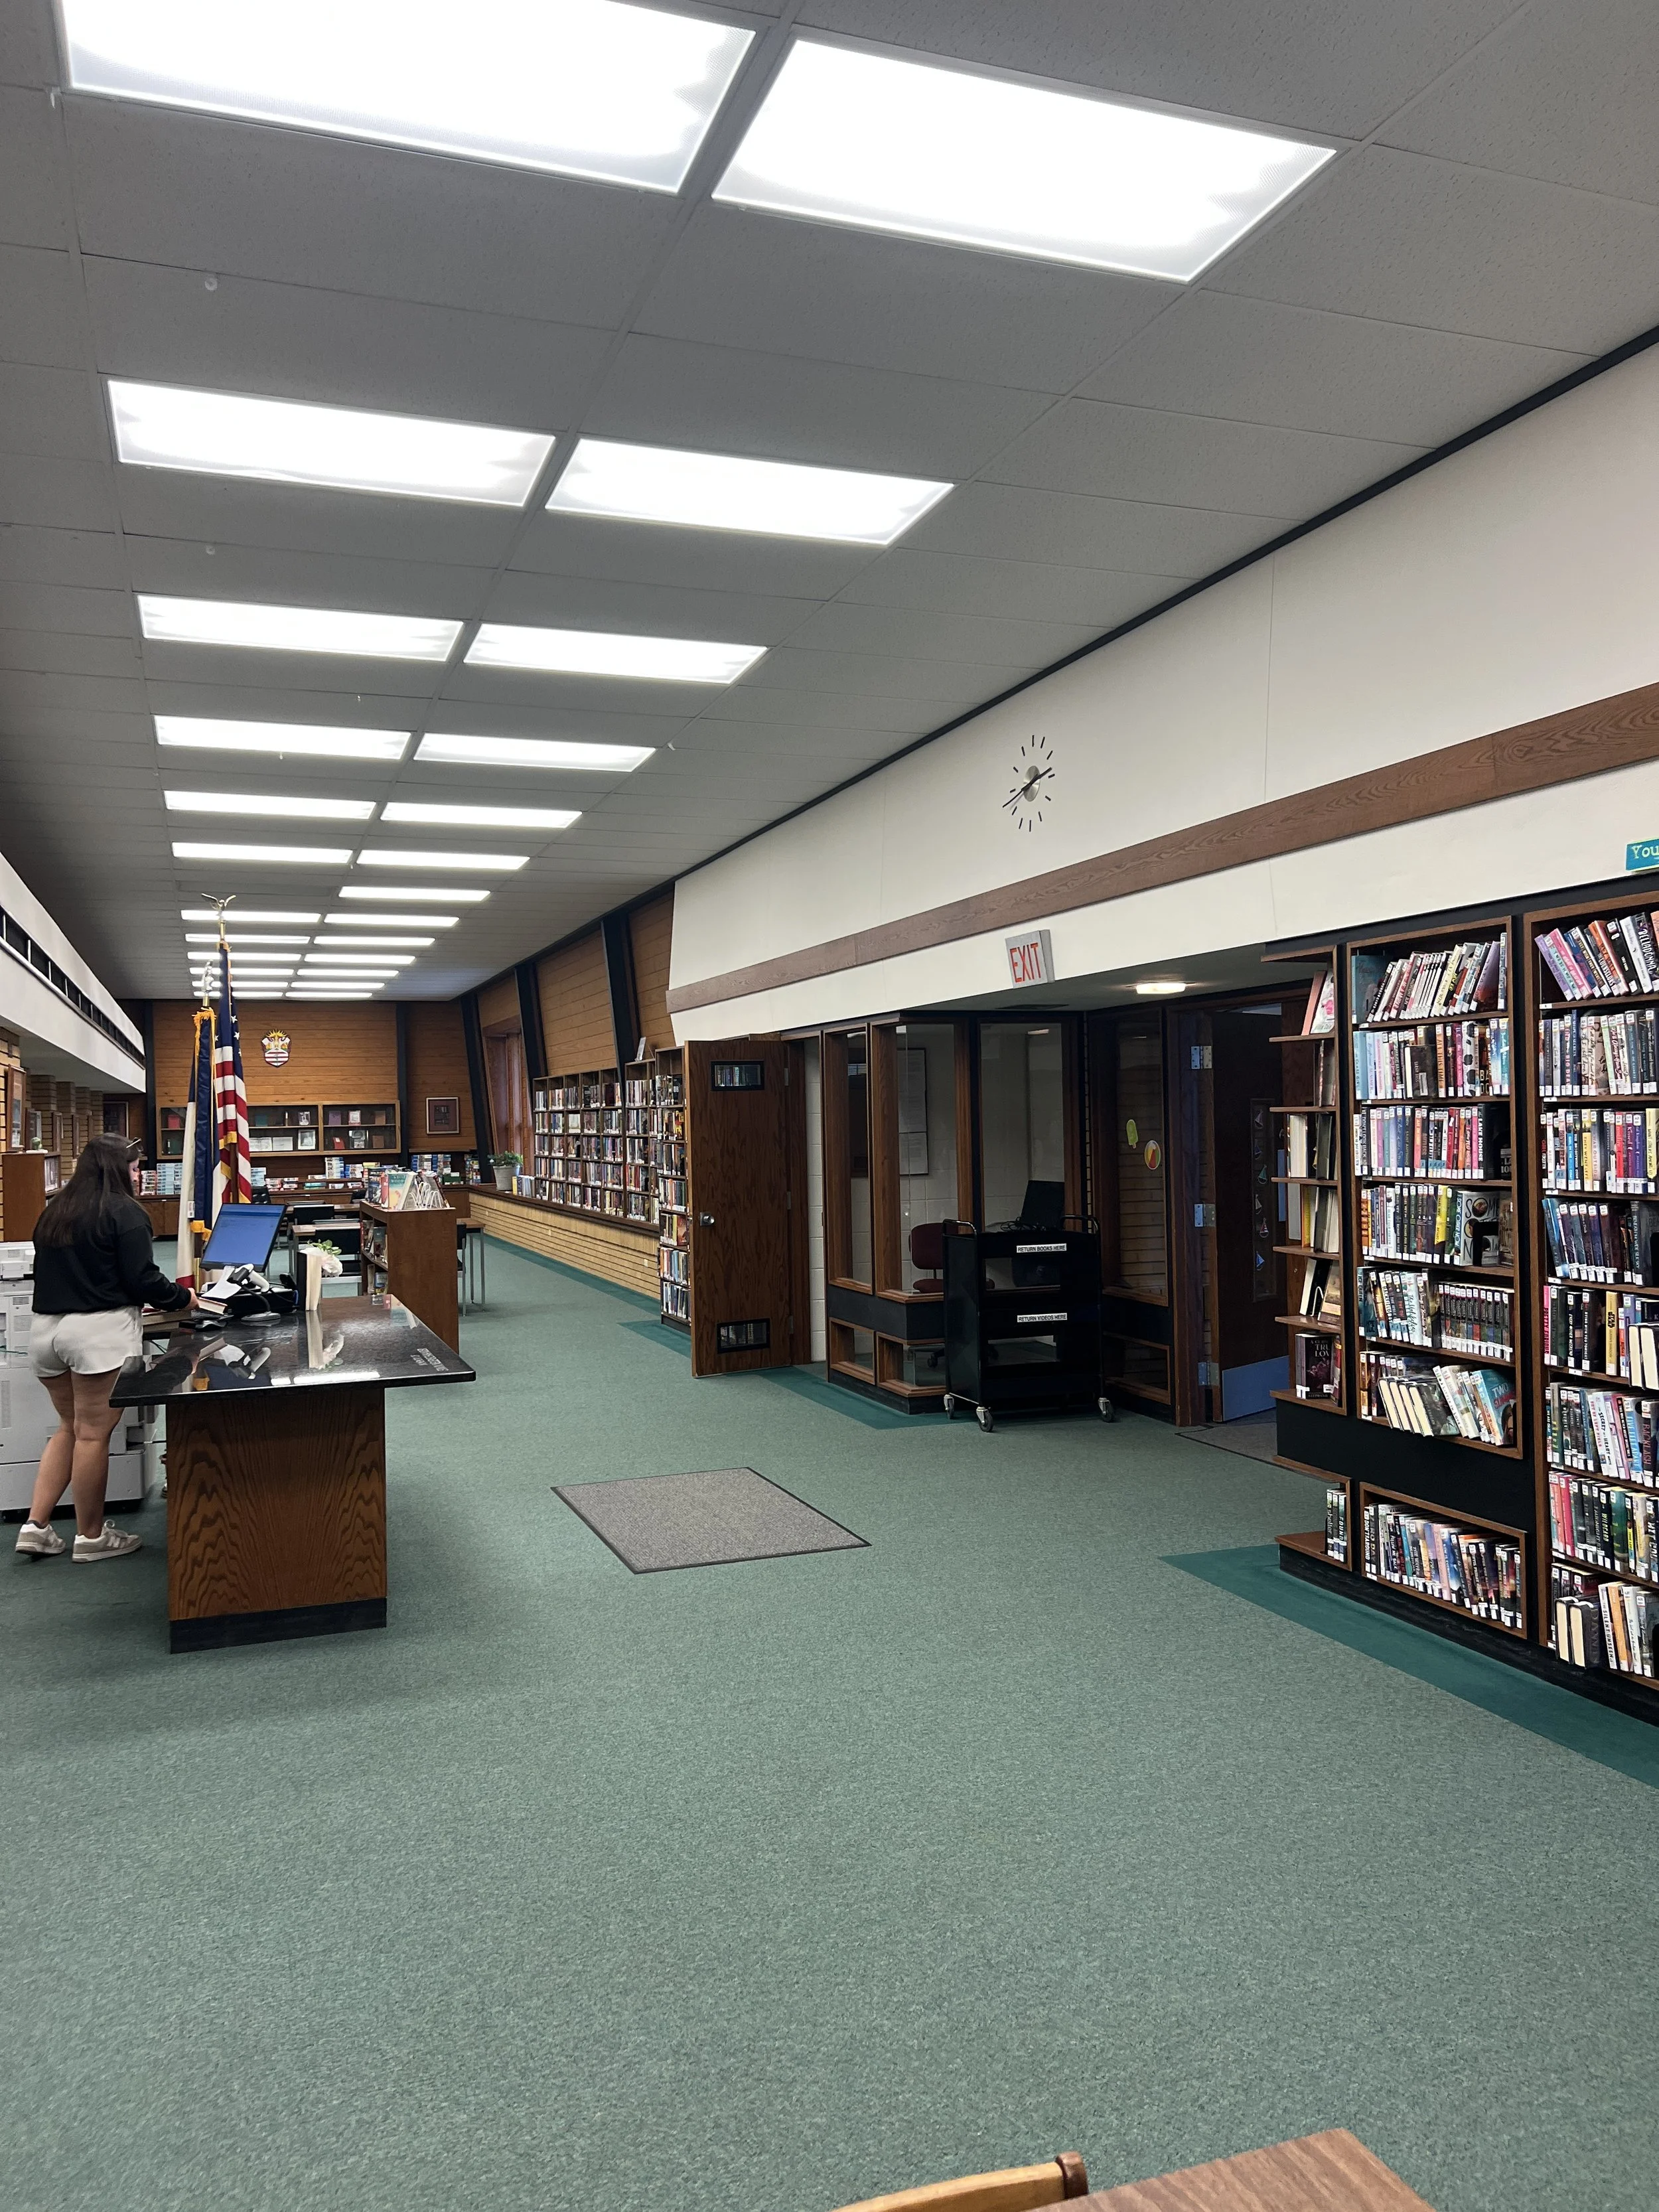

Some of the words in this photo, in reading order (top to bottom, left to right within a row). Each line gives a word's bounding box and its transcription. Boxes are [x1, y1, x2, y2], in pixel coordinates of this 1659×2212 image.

[1009, 942, 1041, 982] EXIT
[1598, 1412, 1607, 1432] SECRET
[1642, 1424, 1651, 1464] BACKLASH
[1600, 1512, 1610, 1542] WILDCARD
[1647, 1521, 1656, 1540] HIT
